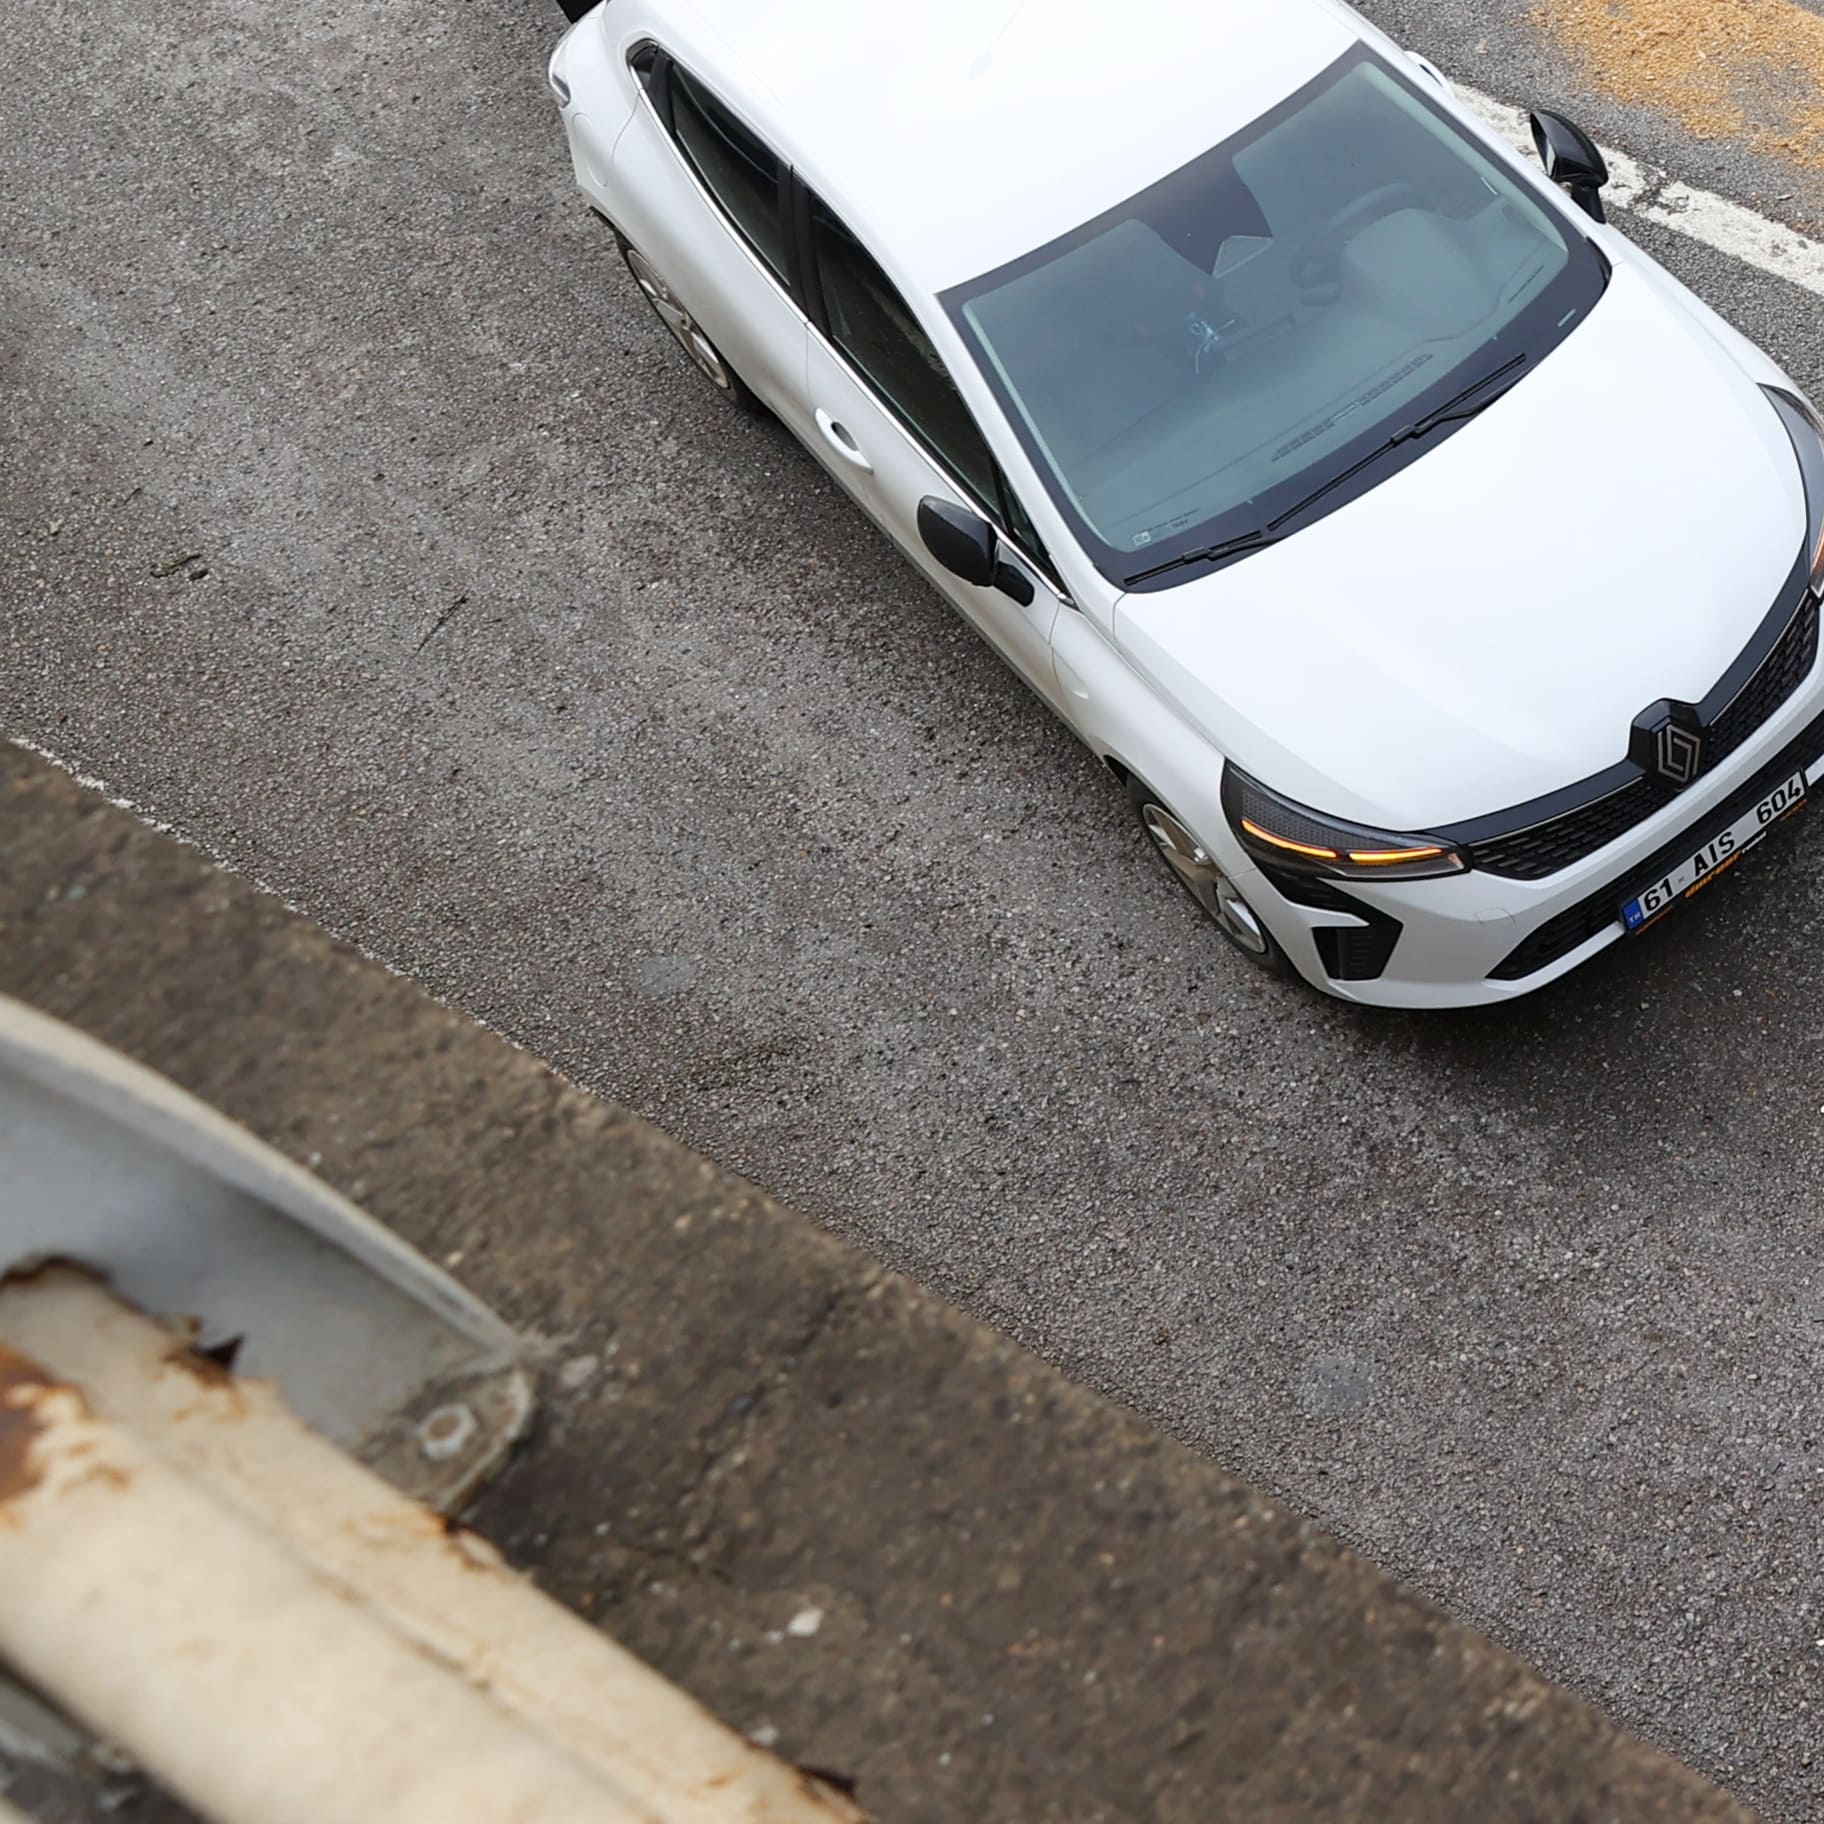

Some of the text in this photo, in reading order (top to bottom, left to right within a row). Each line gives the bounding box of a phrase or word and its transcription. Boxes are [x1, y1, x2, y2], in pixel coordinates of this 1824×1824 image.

[1643, 878, 1673, 911] 61
[1692, 831, 1735, 877] AIS
[1756, 779, 1801, 825] 604
